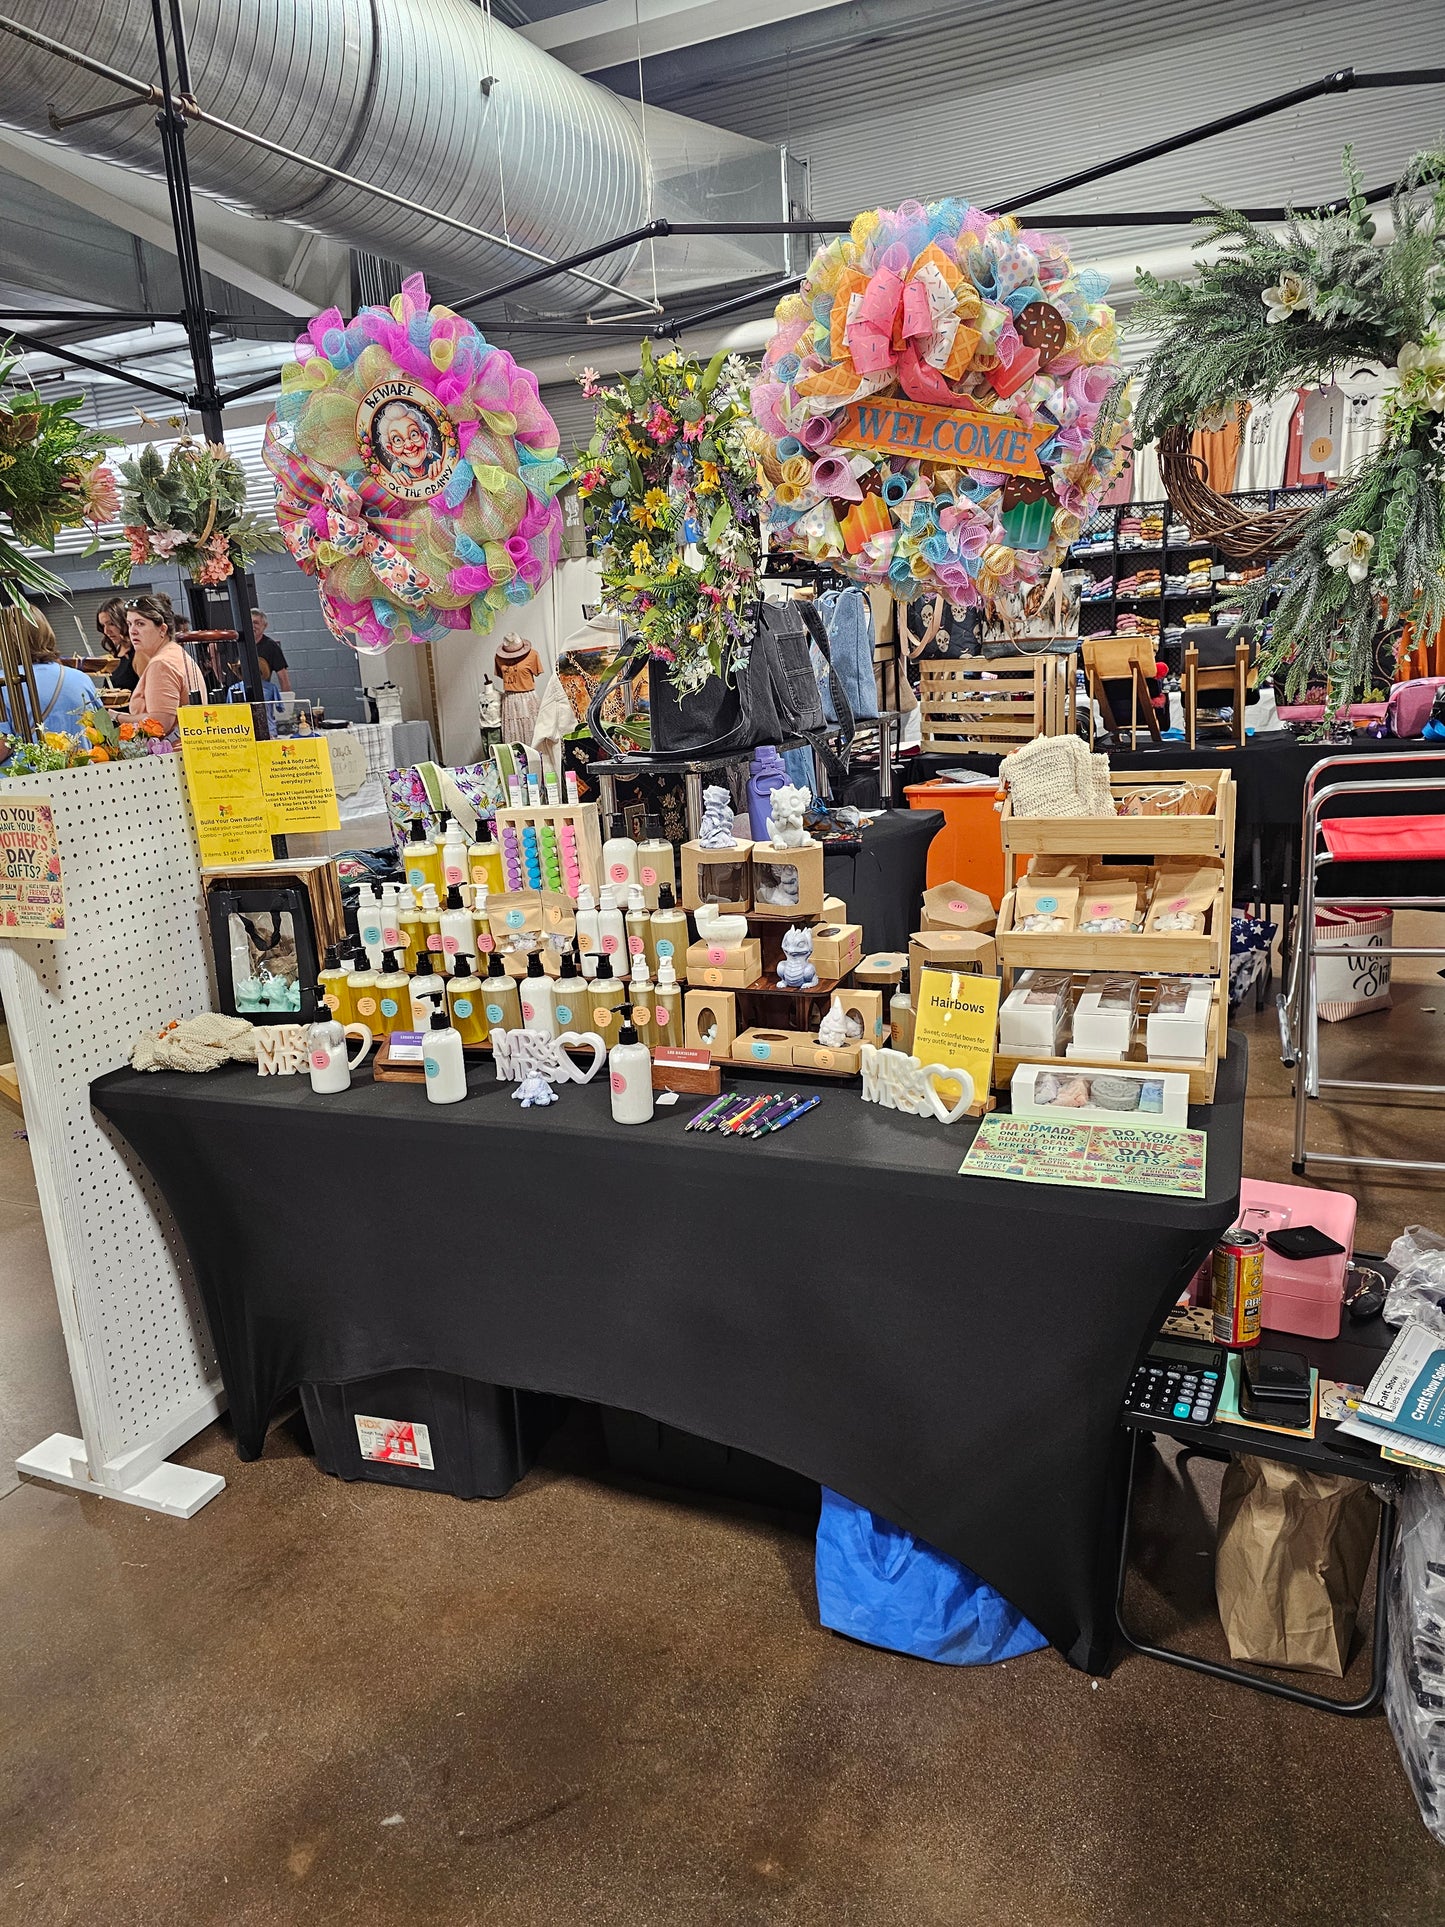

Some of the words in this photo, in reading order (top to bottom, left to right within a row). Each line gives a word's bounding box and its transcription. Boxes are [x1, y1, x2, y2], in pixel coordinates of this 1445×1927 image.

[364, 384, 416, 408] BEWARE
[857, 406, 1032, 464] WELCOME
[388, 483, 401, 494] OF
[405, 488, 421, 497] THE
[425, 464, 453, 495] GRANNY
[183, 725, 250, 736] Eco-Friendly
[0, 810, 8, 821] O
[10, 808, 34, 822] YOU
[17, 822, 36, 832] YOUR
[6, 848, 36, 864] DAY
[7, 864, 40, 878] GIFTS?
[931, 996, 984, 1014] Hairbows
[1000, 1122, 1078, 1134] HANDMADE
[1140, 1130, 1178, 1140] YOU
[1103, 1140, 1189, 1154] MOTHER'S
[1119, 1148, 1165, 1158] DAY
[1114, 1155, 1170, 1166] GIFTS?
[1377, 1389, 1390, 1406] Craft
[1385, 1375, 1398, 1390] Show
[1394, 1377, 1410, 1396] Tracker
[1390, 1395, 1400, 1411] ales
[1411, 1396, 1432, 1420] Craft
[1422, 1375, 1440, 1398] Show
[358, 1418, 382, 1430] HDX
